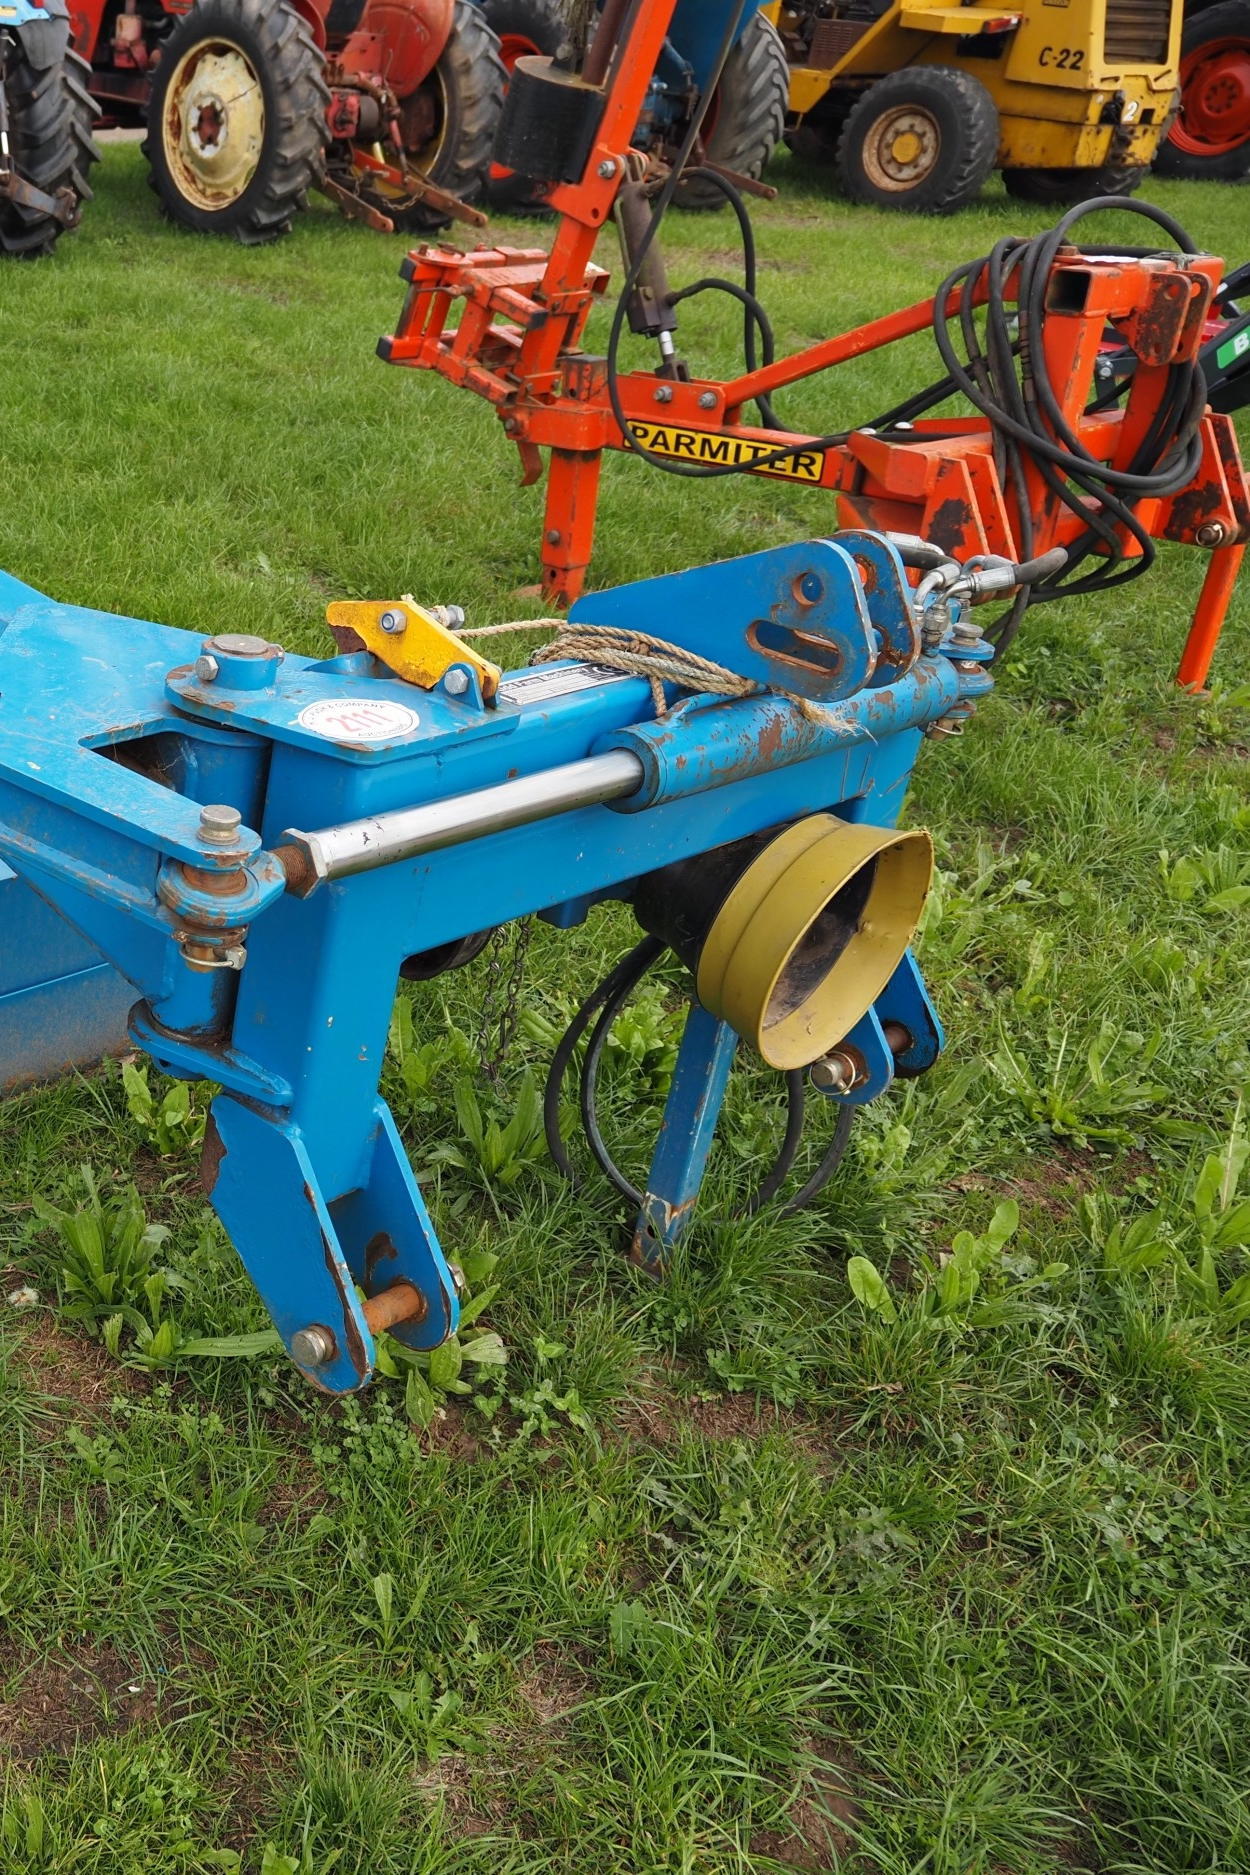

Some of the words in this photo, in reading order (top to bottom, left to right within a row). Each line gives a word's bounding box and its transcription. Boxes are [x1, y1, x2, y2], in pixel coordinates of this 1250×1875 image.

[1039, 47, 1085, 71] C-22
[631, 424, 817, 478] PARMITER
[325, 709, 395, 733] 2111
